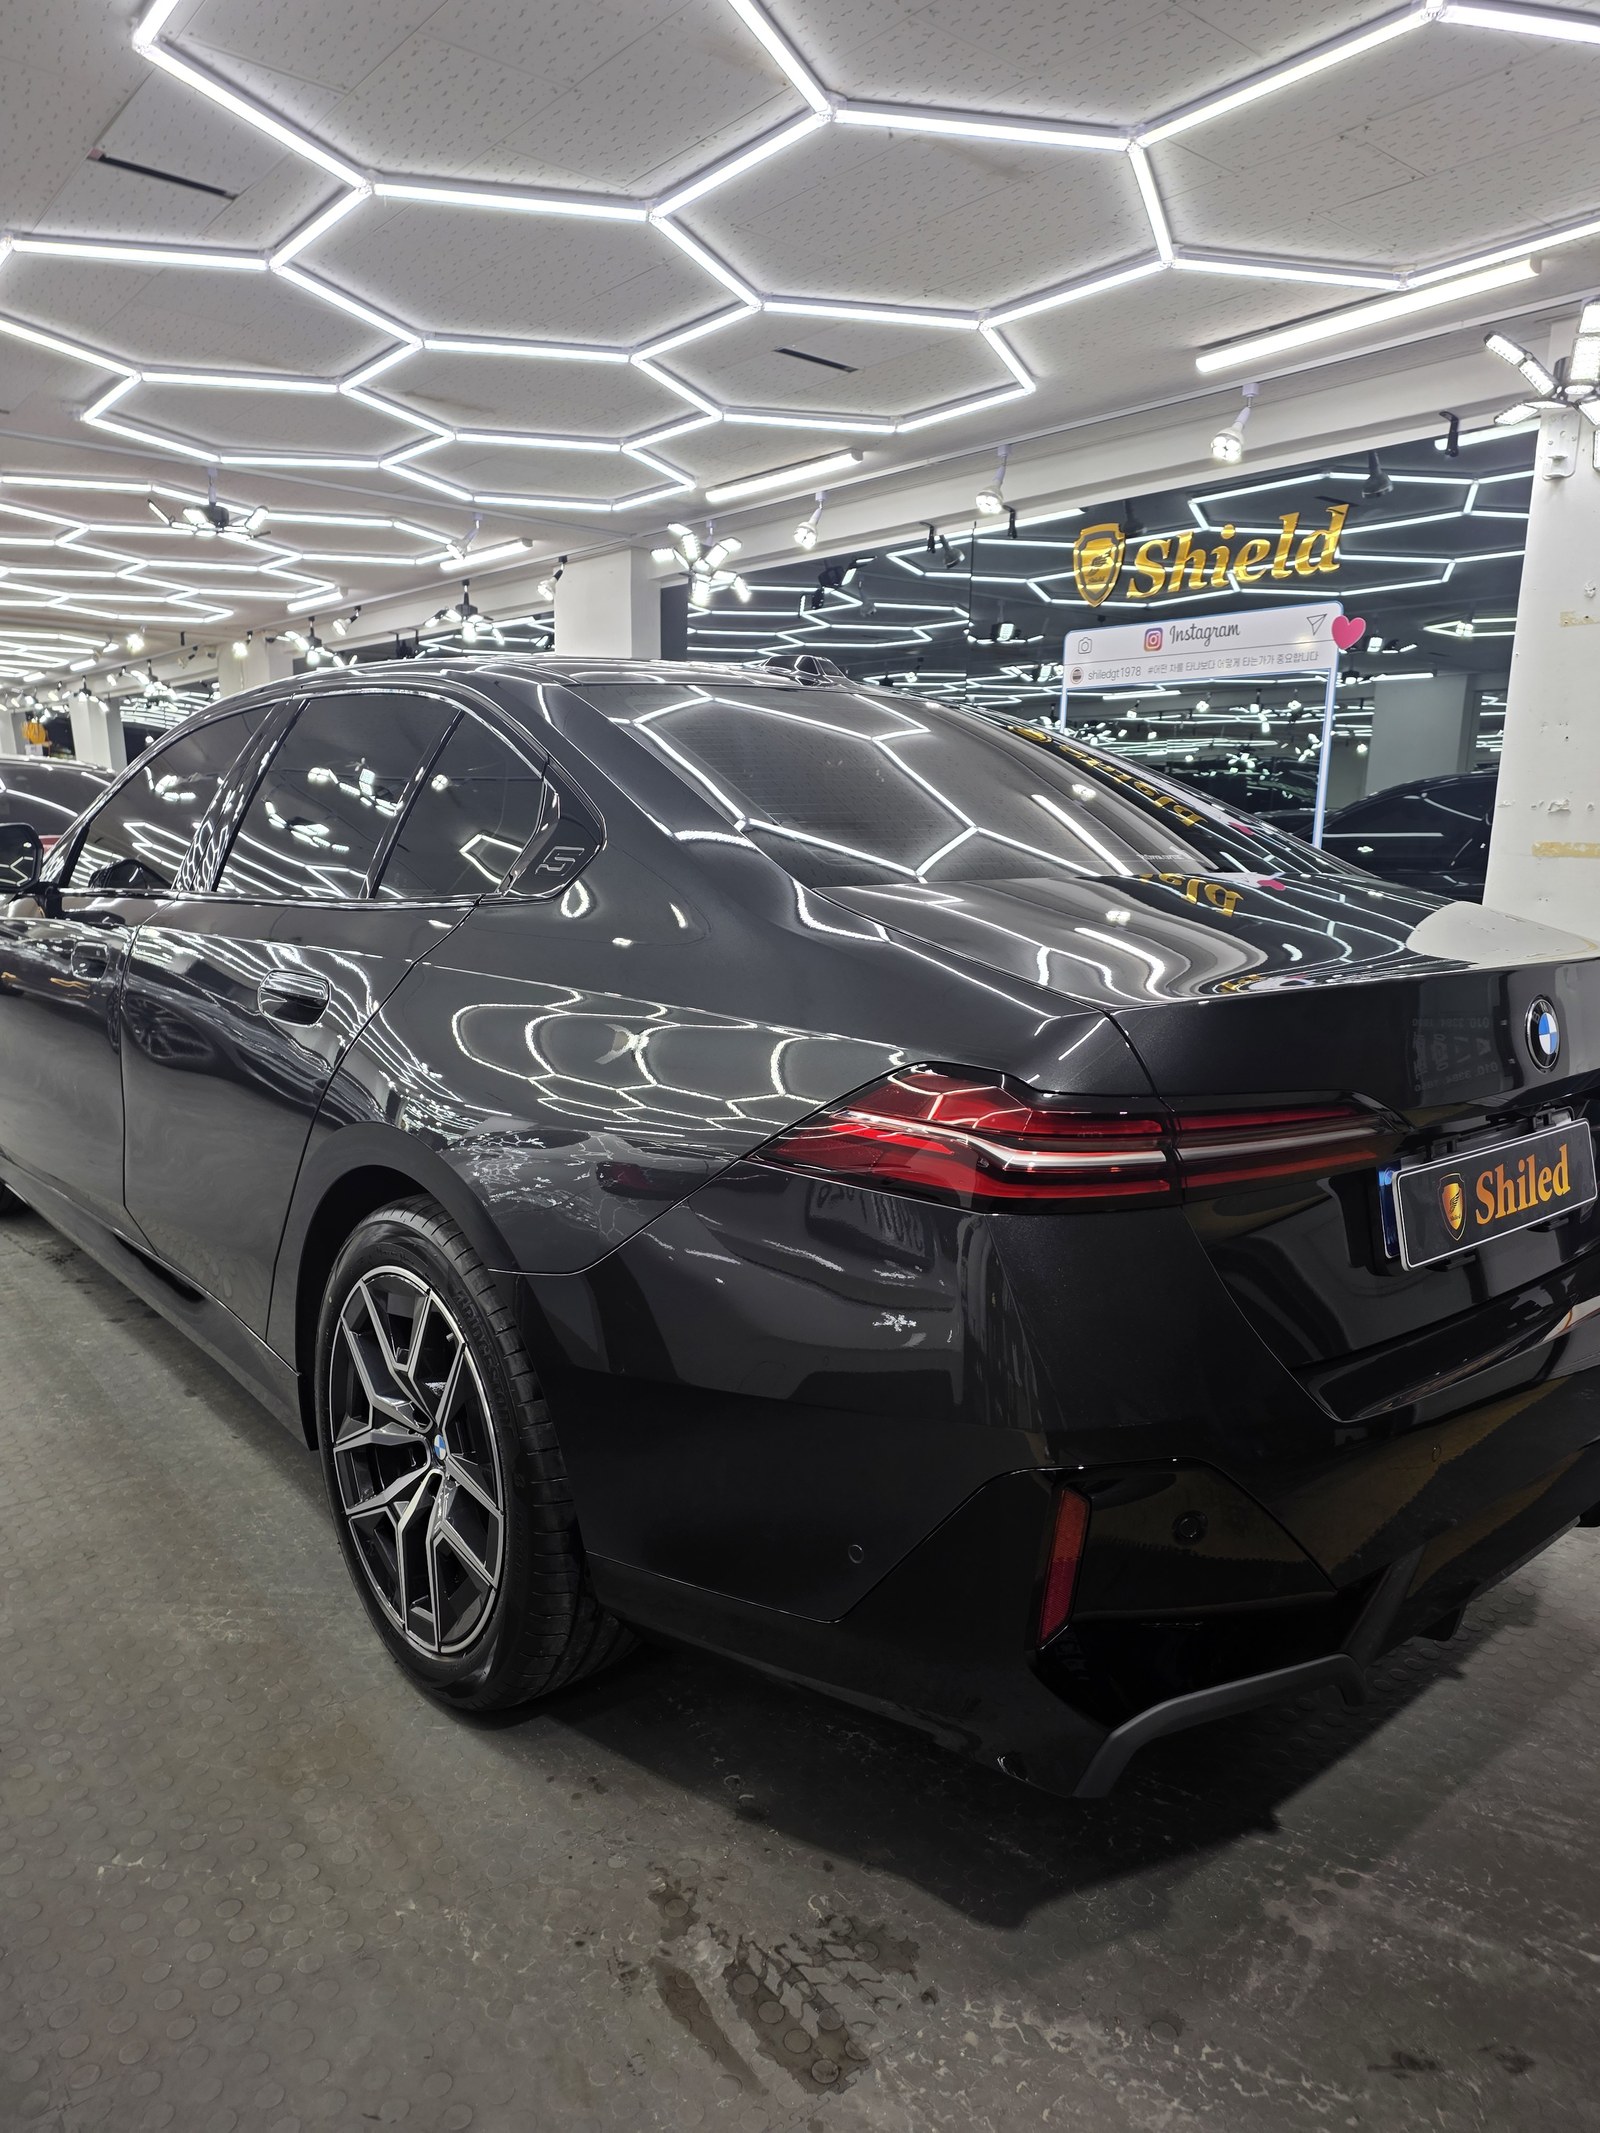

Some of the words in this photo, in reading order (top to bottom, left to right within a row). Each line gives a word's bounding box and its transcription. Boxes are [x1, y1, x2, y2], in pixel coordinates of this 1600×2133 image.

[1126, 504, 1349, 598] Shield
[1169, 623, 1240, 647] Instagram
[1088, 666, 1141, 681] shiledgt1978
[1217, 656, 1240, 669] 어떻게
[1242, 654, 1275, 667] 타는가가
[1276, 651, 1319, 665] 중요합니다
[1475, 1143, 1571, 1225] Shiled
